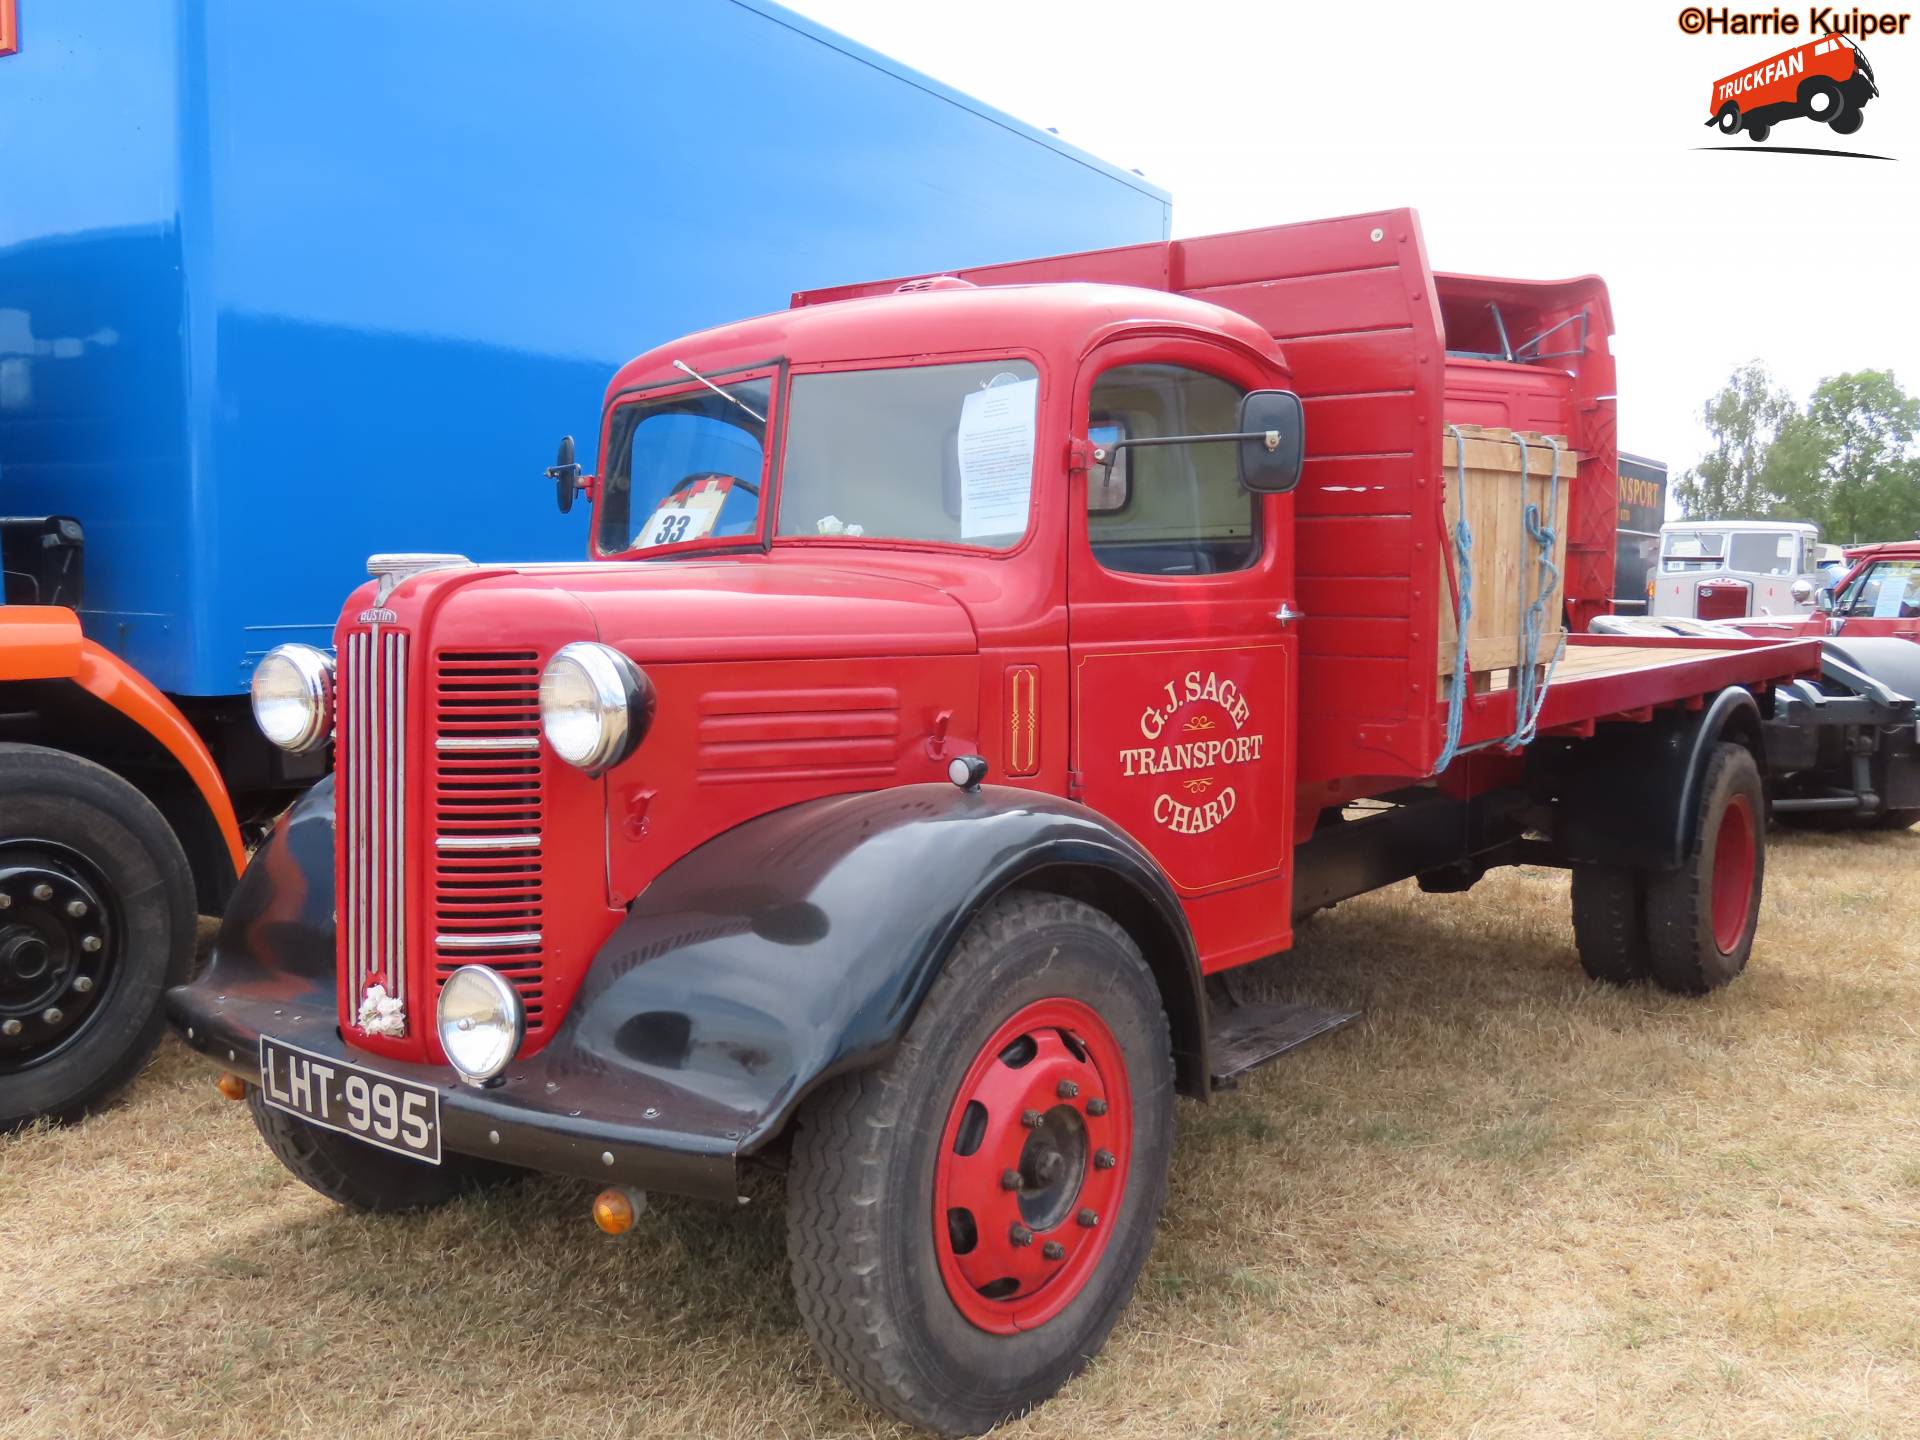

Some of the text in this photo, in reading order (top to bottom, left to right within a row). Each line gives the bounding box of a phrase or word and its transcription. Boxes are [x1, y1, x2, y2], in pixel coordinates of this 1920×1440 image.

[654, 515, 691, 544] 33
[360, 608, 393, 622] AUSTIN
[1119, 735, 1263, 777] TRANSPORT
[1153, 786, 1236, 834] CHARD
[345, 1075, 429, 1149] 995
